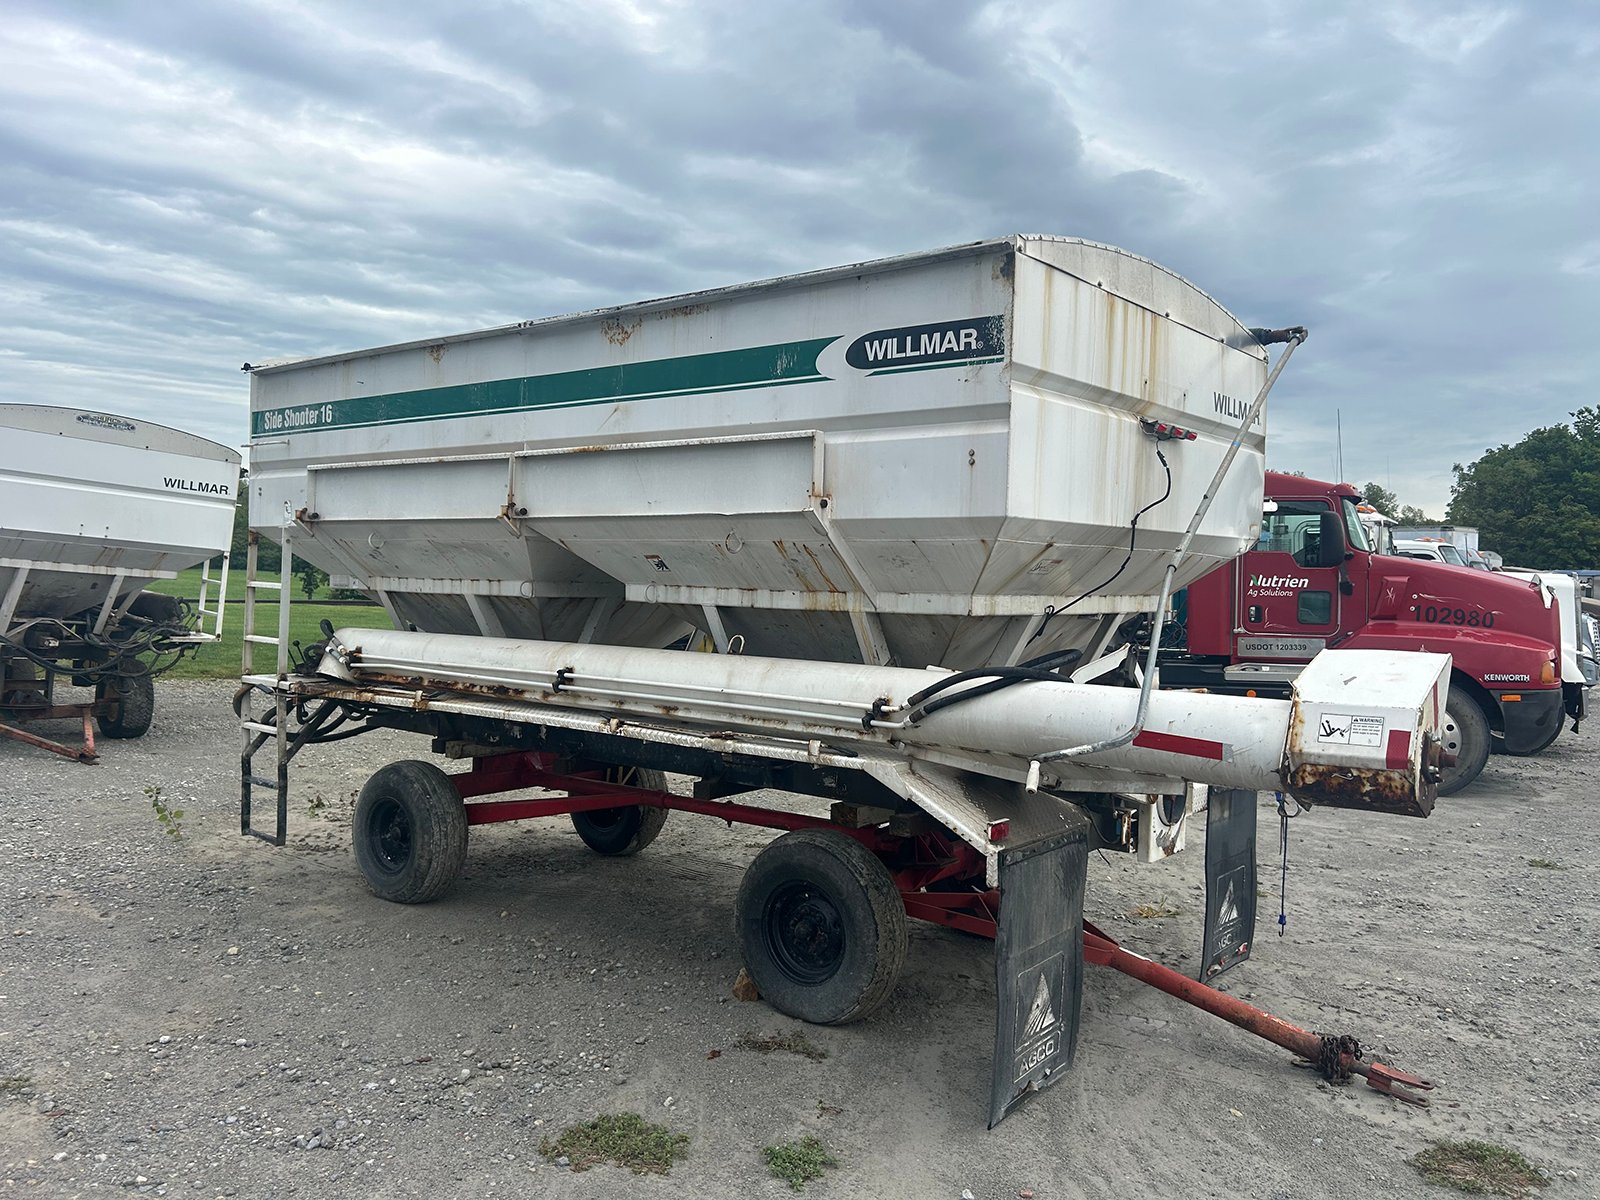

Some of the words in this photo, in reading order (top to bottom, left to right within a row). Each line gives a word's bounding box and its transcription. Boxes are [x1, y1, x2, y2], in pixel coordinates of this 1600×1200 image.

[264, 411, 283, 430] Side
[284, 407, 319, 428] Shooter
[320, 404, 333, 423] 16
[163, 477, 229, 495] WILLMAR
[1249, 574, 1309, 588] Nutrien
[1247, 588, 1258, 598] Ag
[1259, 587, 1293, 597] Solutions
[1414, 604, 1495, 629] 102980
[1245, 643, 1274, 651] USDOT
[1484, 673, 1530, 683] KENWORTH
[1019, 1039, 1055, 1076] AGCO
